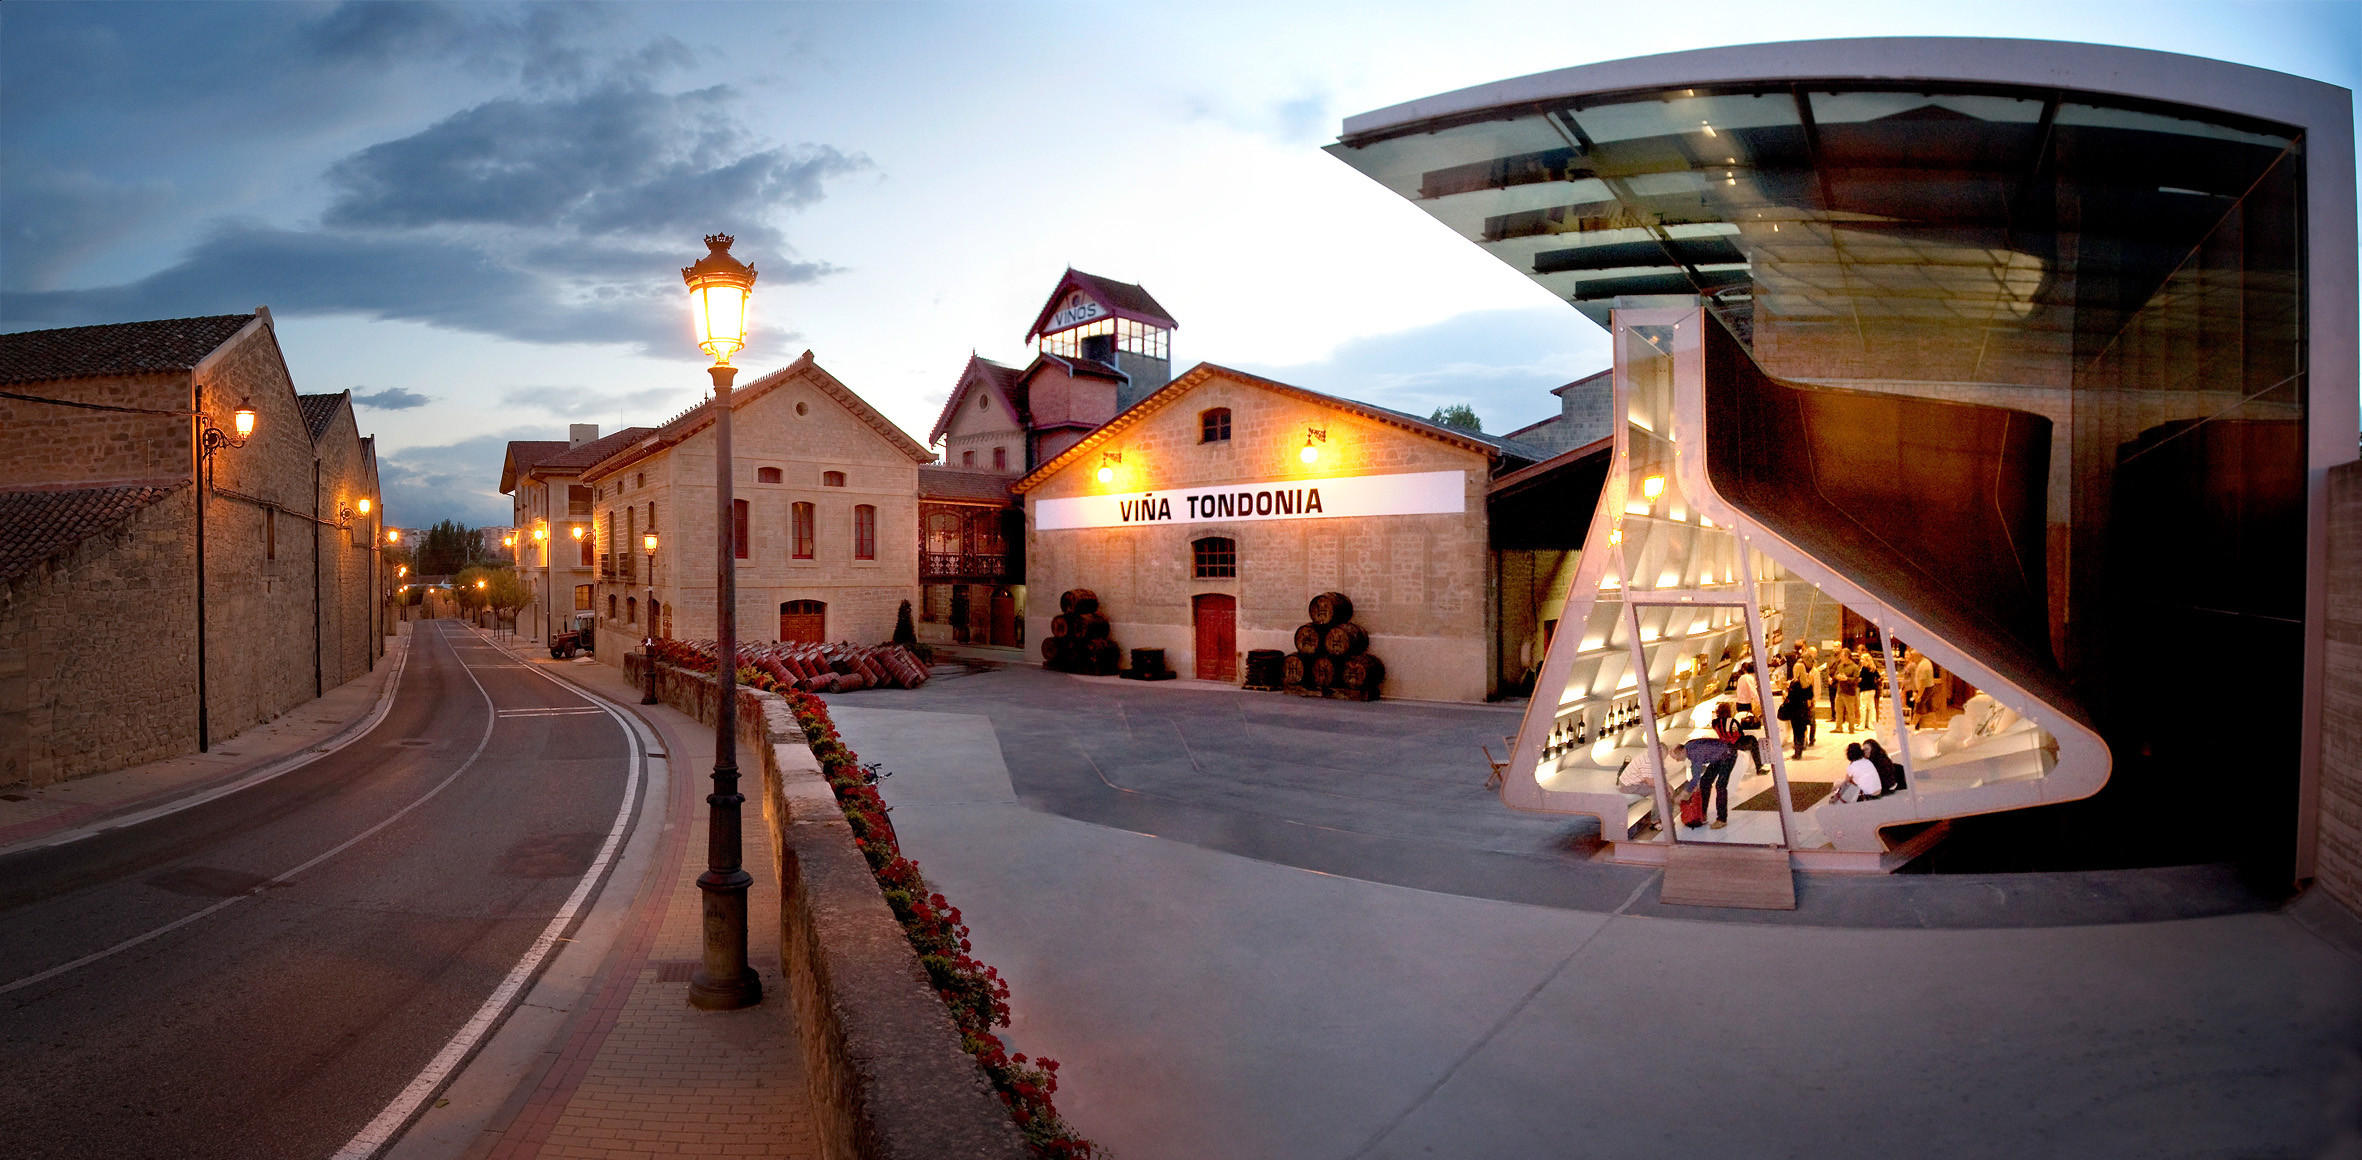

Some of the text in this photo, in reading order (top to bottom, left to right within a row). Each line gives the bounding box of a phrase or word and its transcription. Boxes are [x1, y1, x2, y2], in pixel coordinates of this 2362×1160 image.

[1055, 303, 1096, 326] VINOS
[1120, 488, 1323, 522] VIÑA TONDONIA
